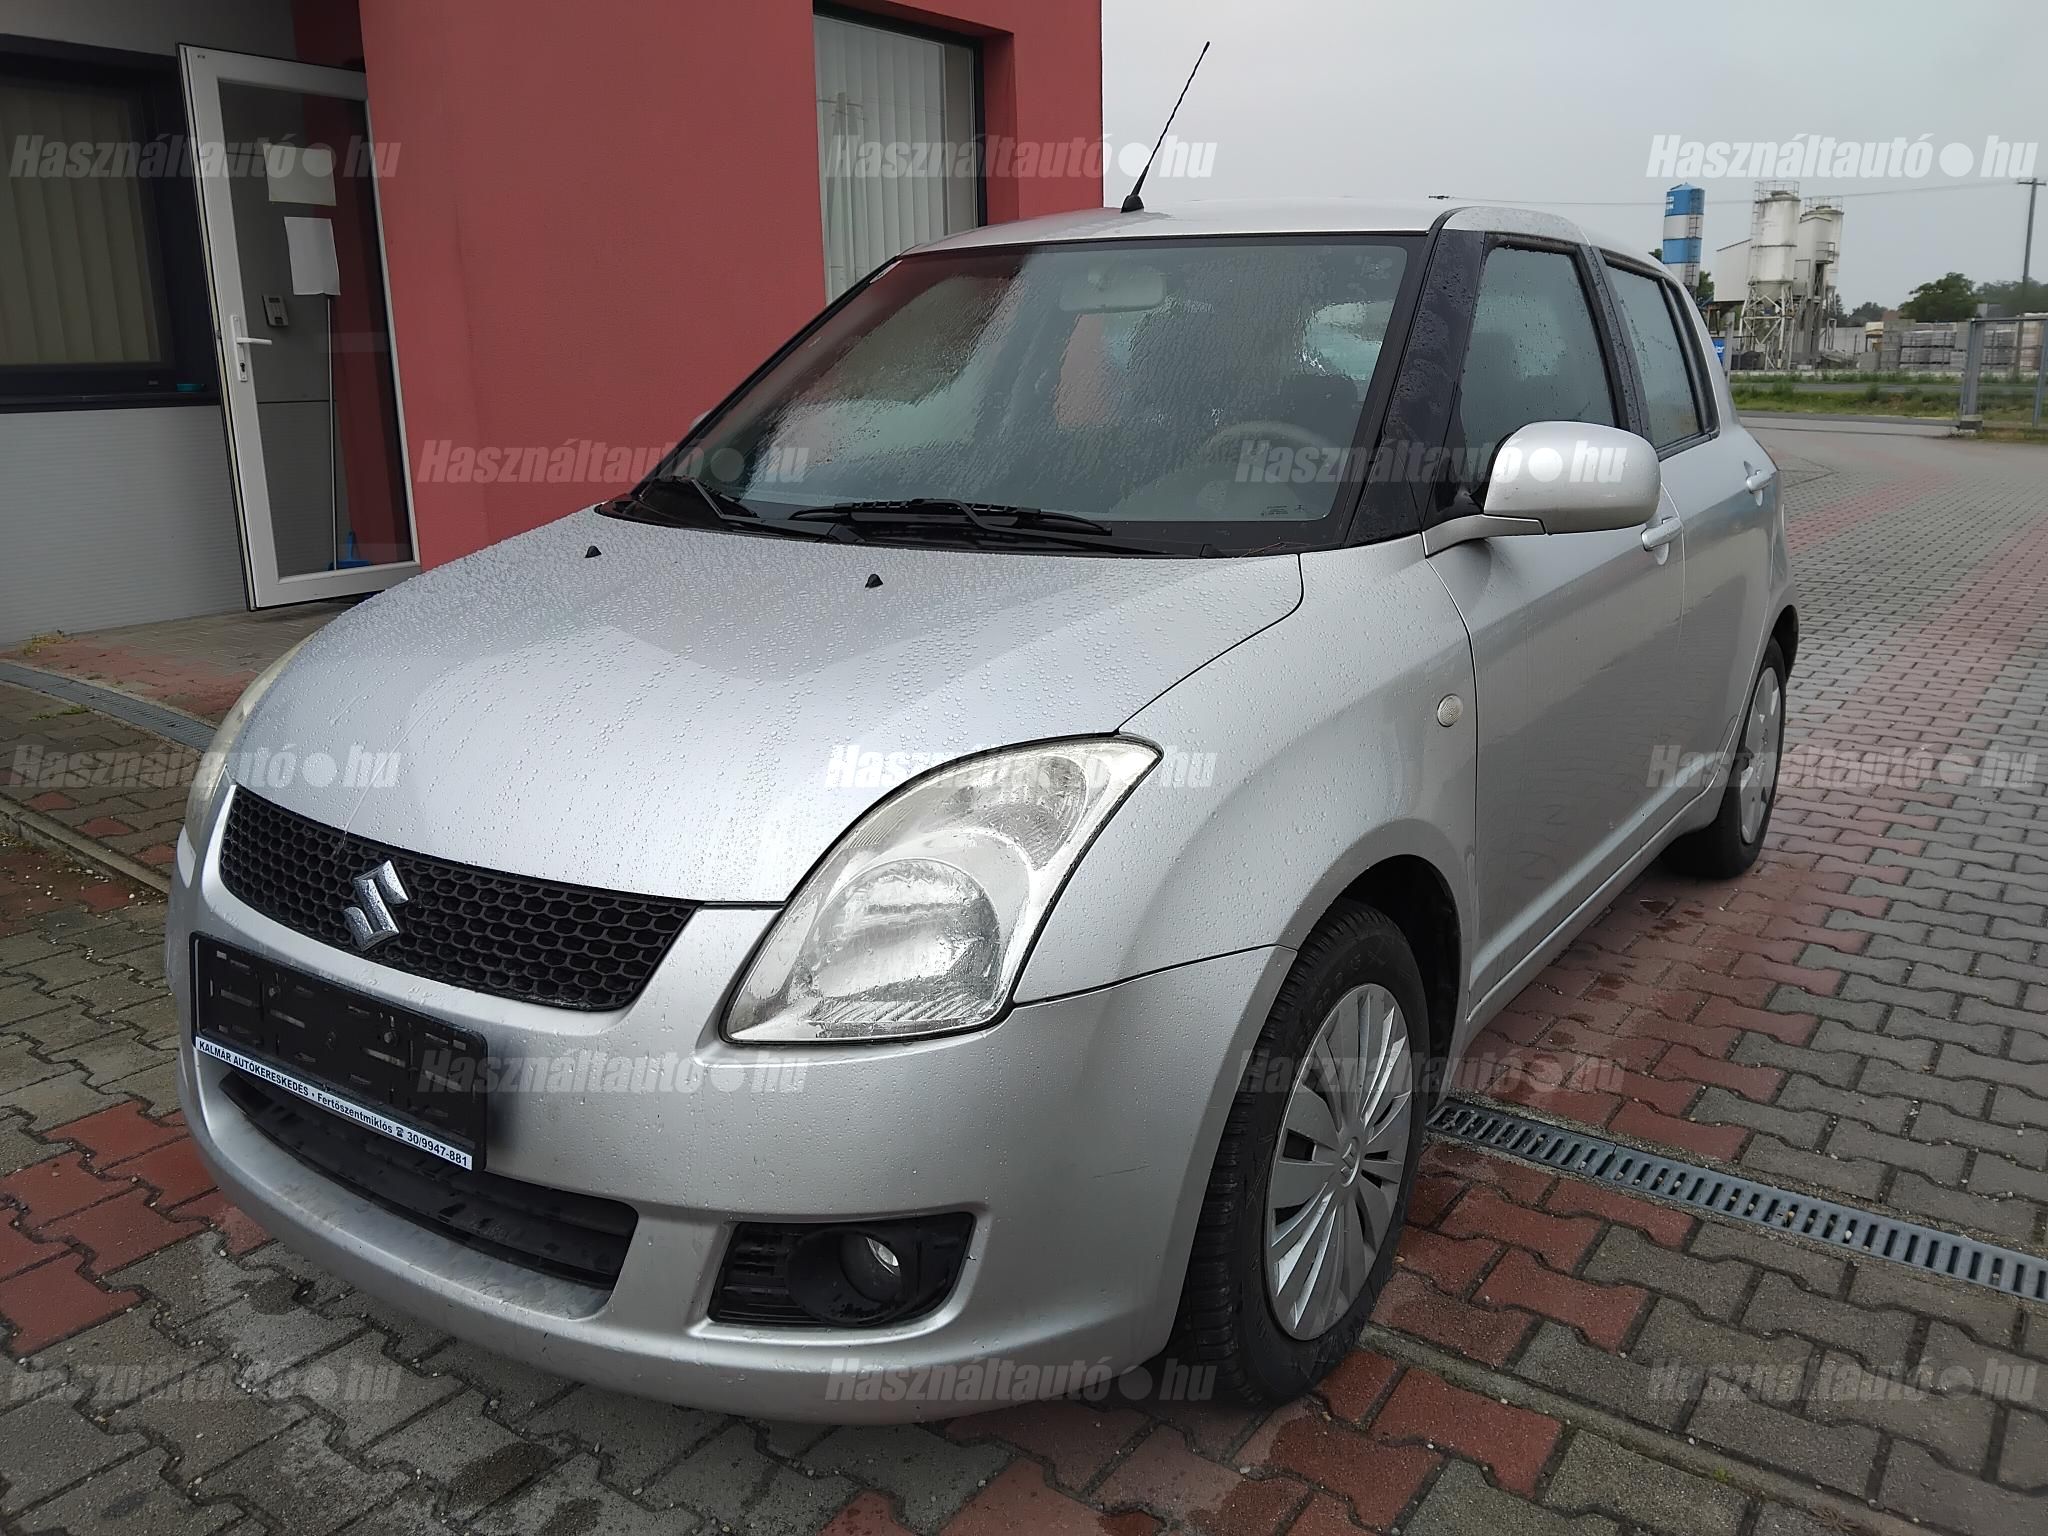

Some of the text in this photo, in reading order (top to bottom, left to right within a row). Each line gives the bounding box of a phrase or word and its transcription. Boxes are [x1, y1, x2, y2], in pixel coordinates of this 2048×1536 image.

[199, 1040, 232, 1063] KALMÁR
[233, 1057, 309, 1096] AUTÓKERESKEDÉS
[407, 1131, 467, 1167] 30/9947-881
